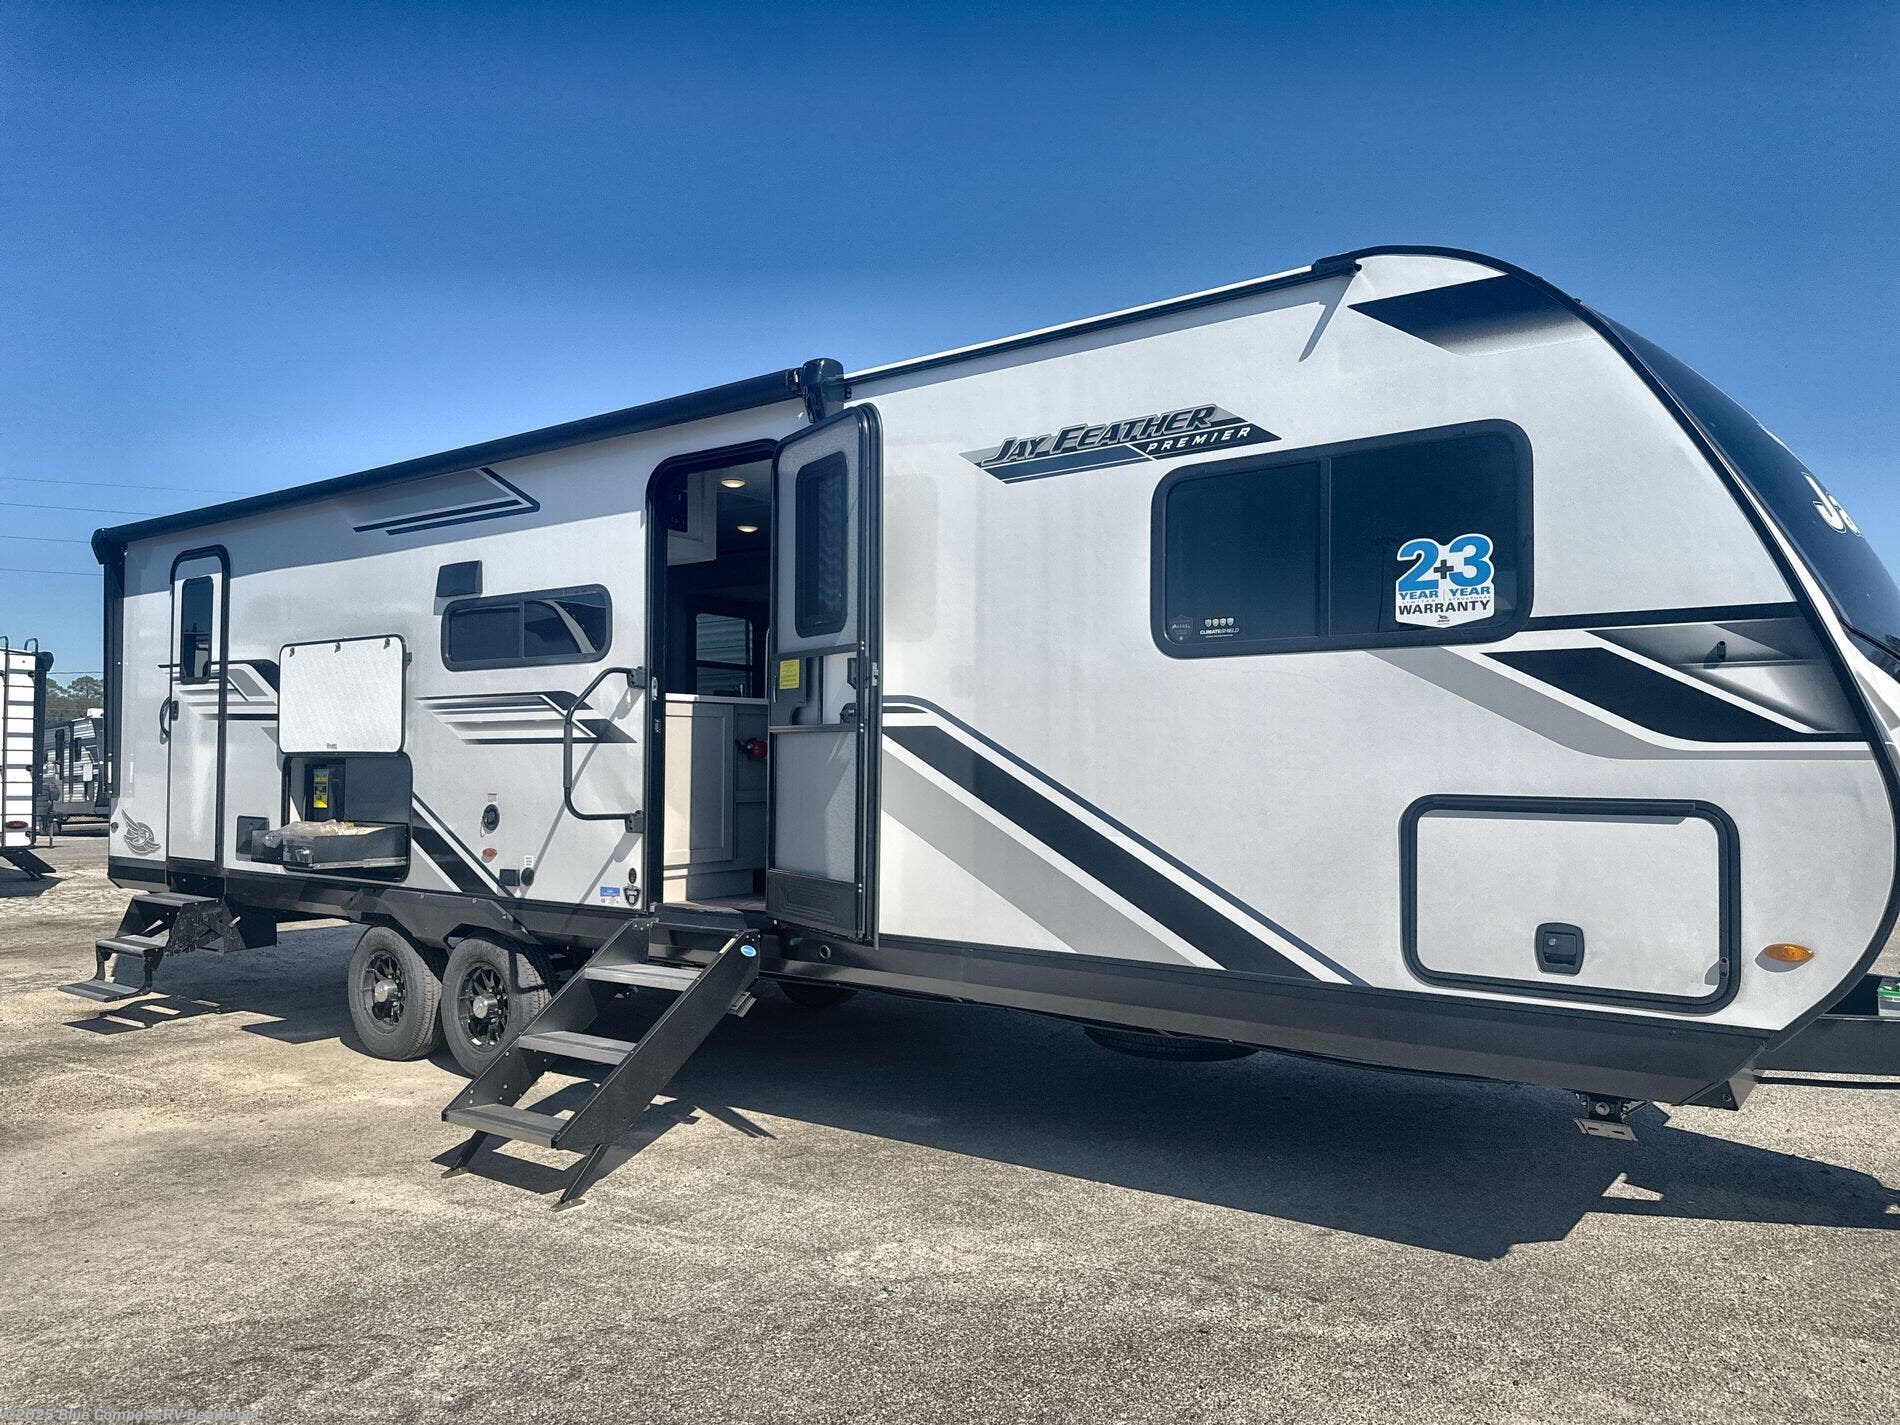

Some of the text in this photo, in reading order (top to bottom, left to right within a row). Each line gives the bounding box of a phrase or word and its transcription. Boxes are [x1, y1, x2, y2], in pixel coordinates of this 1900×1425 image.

[982, 404, 1217, 466] JAY FEATHER
[1147, 426, 1251, 453] PREMIER
[1399, 590, 1439, 600] YEAR
[1449, 586, 1491, 597] YEAR
[1398, 600, 1491, 615] WARRANTY
